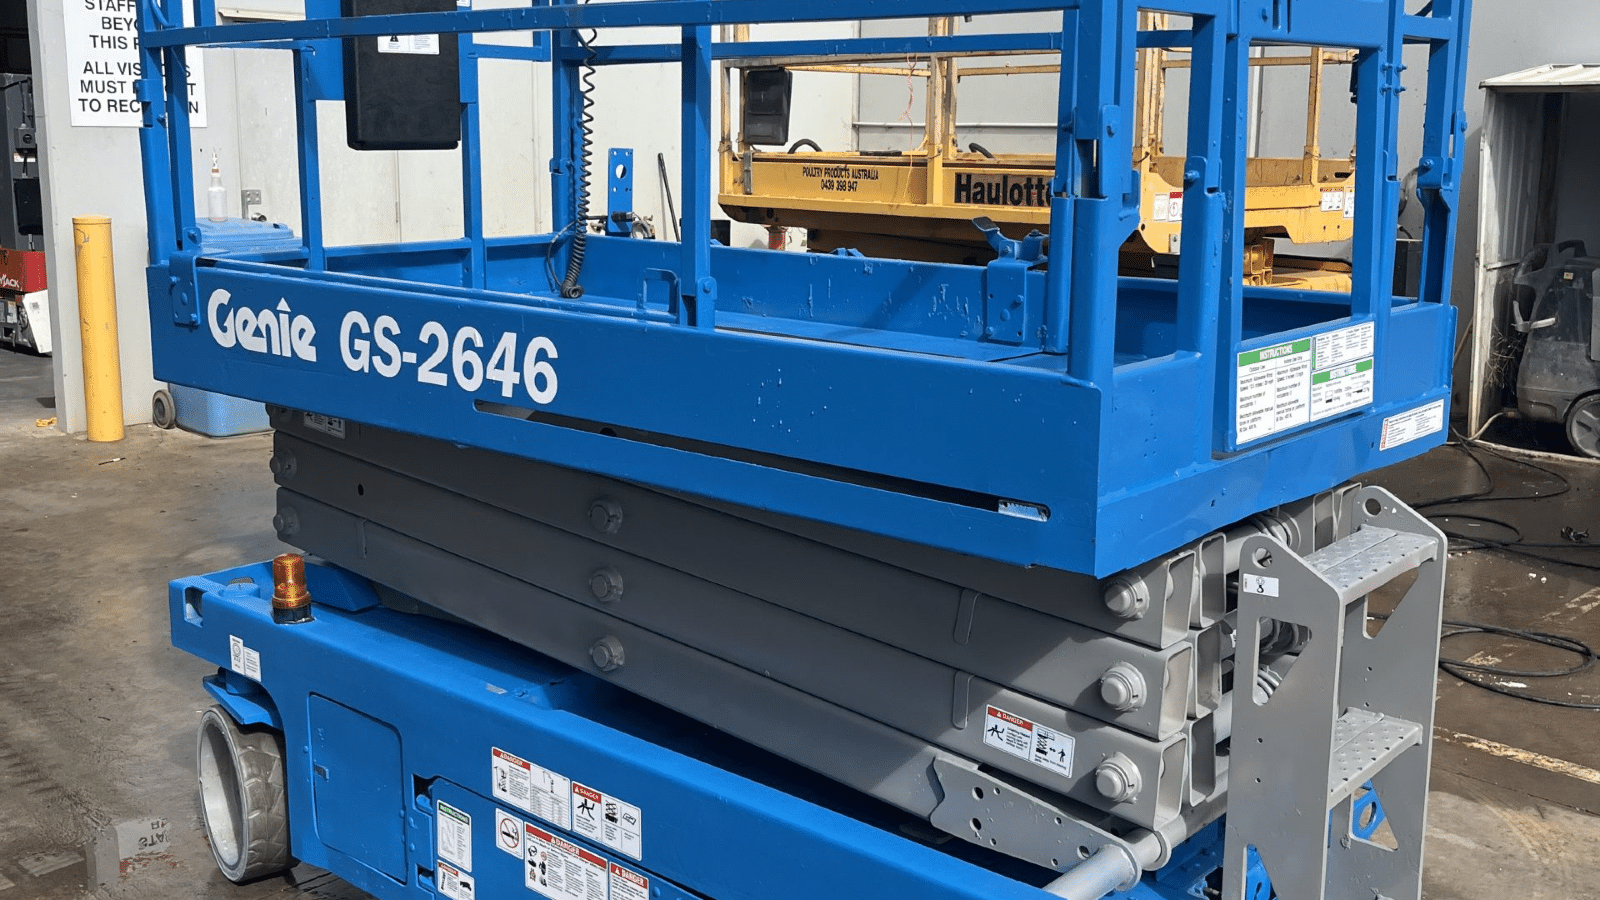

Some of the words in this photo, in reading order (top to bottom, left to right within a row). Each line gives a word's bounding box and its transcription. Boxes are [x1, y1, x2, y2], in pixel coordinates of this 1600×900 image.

[85, 0, 136, 13] STAFF
[89, 35, 128, 49] THIS
[83, 61, 114, 75] ALL
[80, 80, 127, 94] MUST
[78, 98, 102, 112] TO
[207, 288, 317, 362] Genie
[340, 310, 559, 404] GS-2646
[1002, 713, 1024, 726] DANGER
